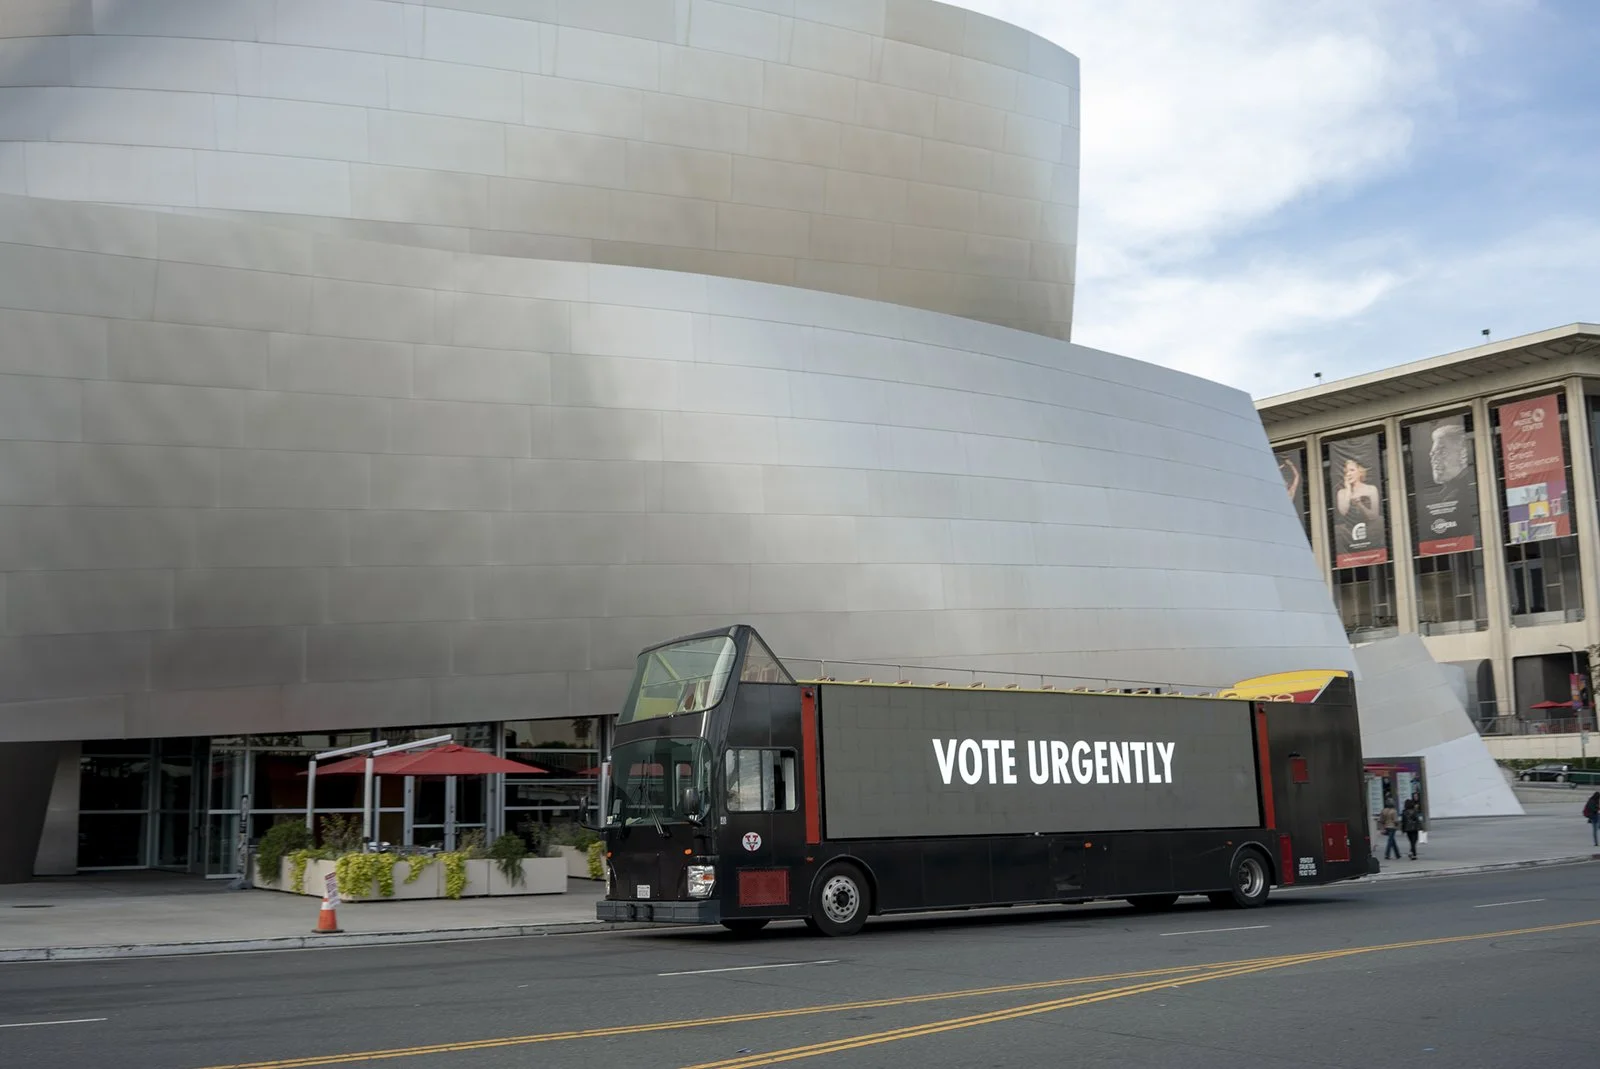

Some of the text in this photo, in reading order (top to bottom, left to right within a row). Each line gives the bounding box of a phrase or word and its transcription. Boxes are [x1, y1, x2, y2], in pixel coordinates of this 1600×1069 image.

[1506, 440, 1537, 451] Where
[1508, 450, 1535, 461] Great
[1509, 455, 1560, 471] Experiences
[932, 738, 1176, 785] VOTE URGENTLY
